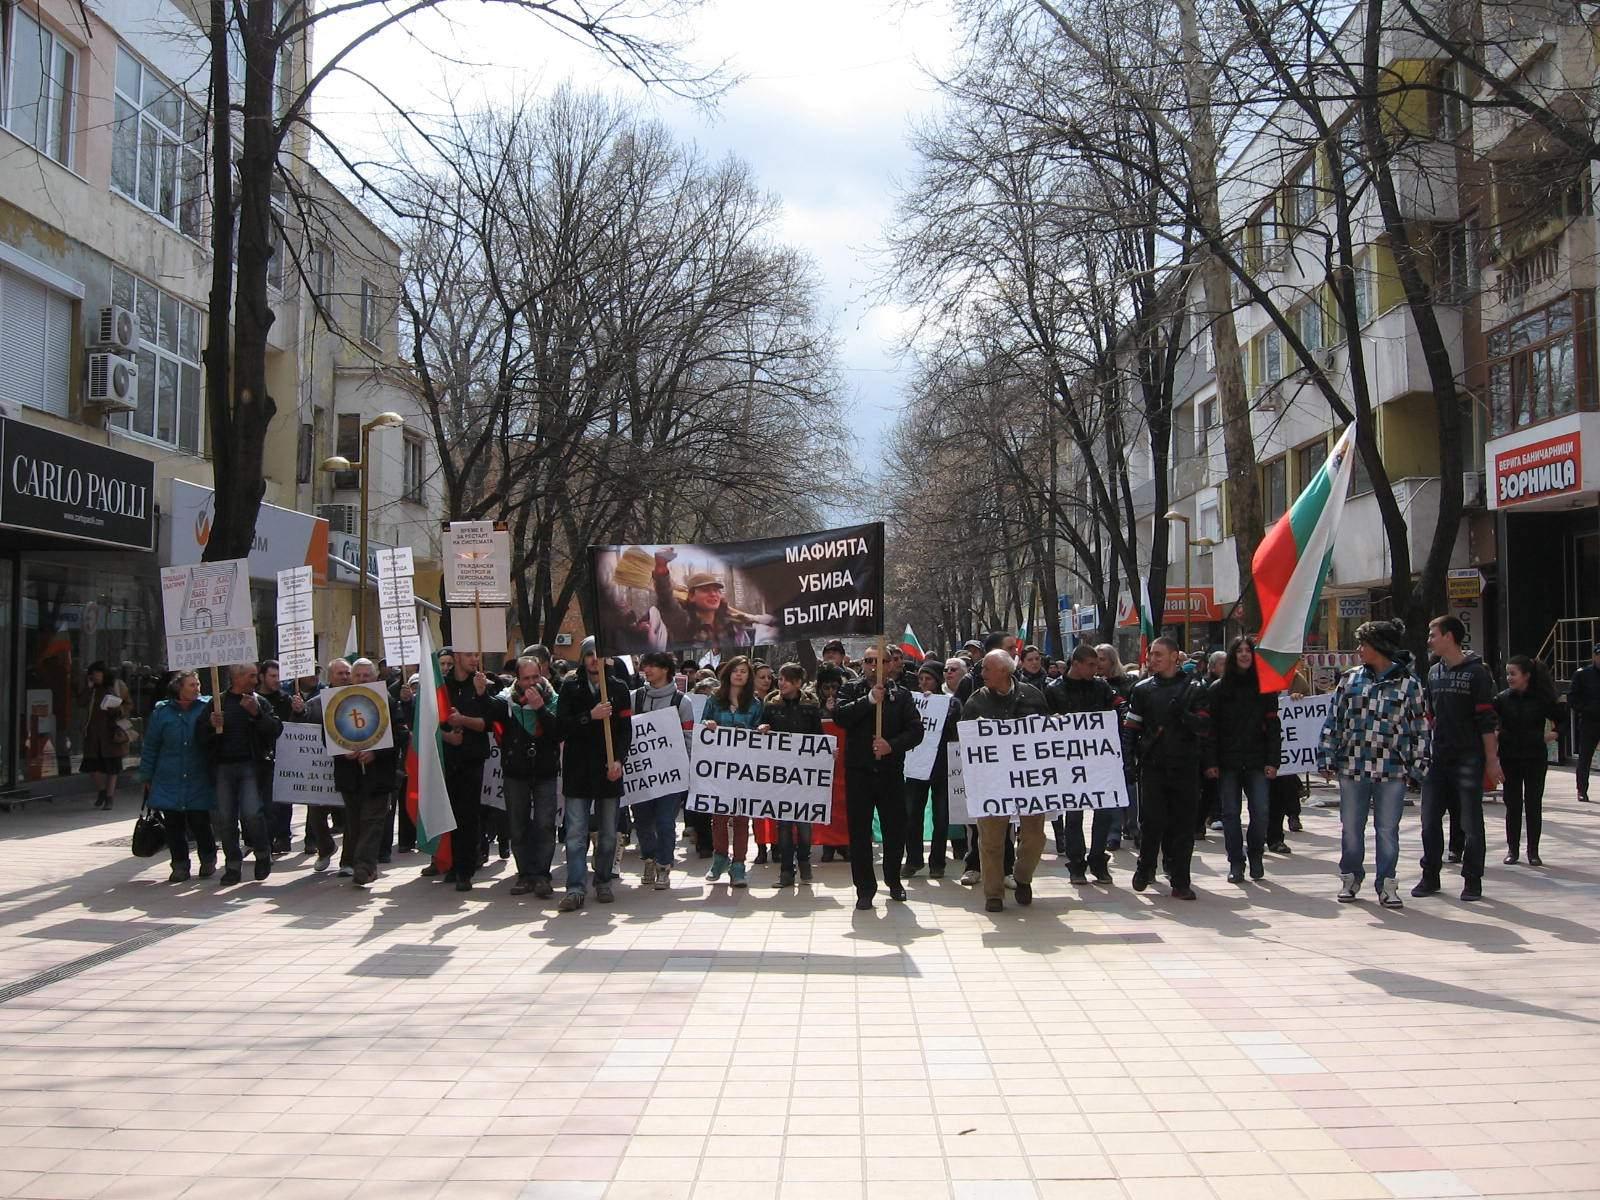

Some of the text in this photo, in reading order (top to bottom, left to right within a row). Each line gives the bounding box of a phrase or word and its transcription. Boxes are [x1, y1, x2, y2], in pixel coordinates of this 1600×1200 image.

[12, 454, 147, 520] CARLO PAOLLI
[1500, 459, 1575, 500] ЗОРНИЦА
[785, 537, 869, 564] МАФИЯТА
[798, 569, 854, 593] УБИВА
[784, 598, 874, 626] БЪЛГАРИЯ!
[1340, 608, 1367, 616] ТОТО
[284, 732, 317, 741] МАФИЯ
[635, 722, 656, 739] ДА
[922, 717, 938, 732] ЕН
[978, 712, 1105, 737] БЪЛГАРИЯ
[627, 736, 673, 756] БОТЯ,
[700, 727, 832, 756] СПРЕТЕ ДА
[967, 739, 1121, 764] НЕ Е БЕДНА,
[312, 760, 334, 768] КЪРТ
[623, 757, 652, 775] ВЕЯ
[1280, 747, 1318, 766] БУД
[623, 769, 681, 793] ЛГАРИЯ
[695, 759, 832, 787] ОГРАБВАТЕ
[1009, 766, 1087, 788] НЕЯ Я
[496, 786, 504, 798] 2
[694, 794, 827, 822] БЪЛГАРИЯ
